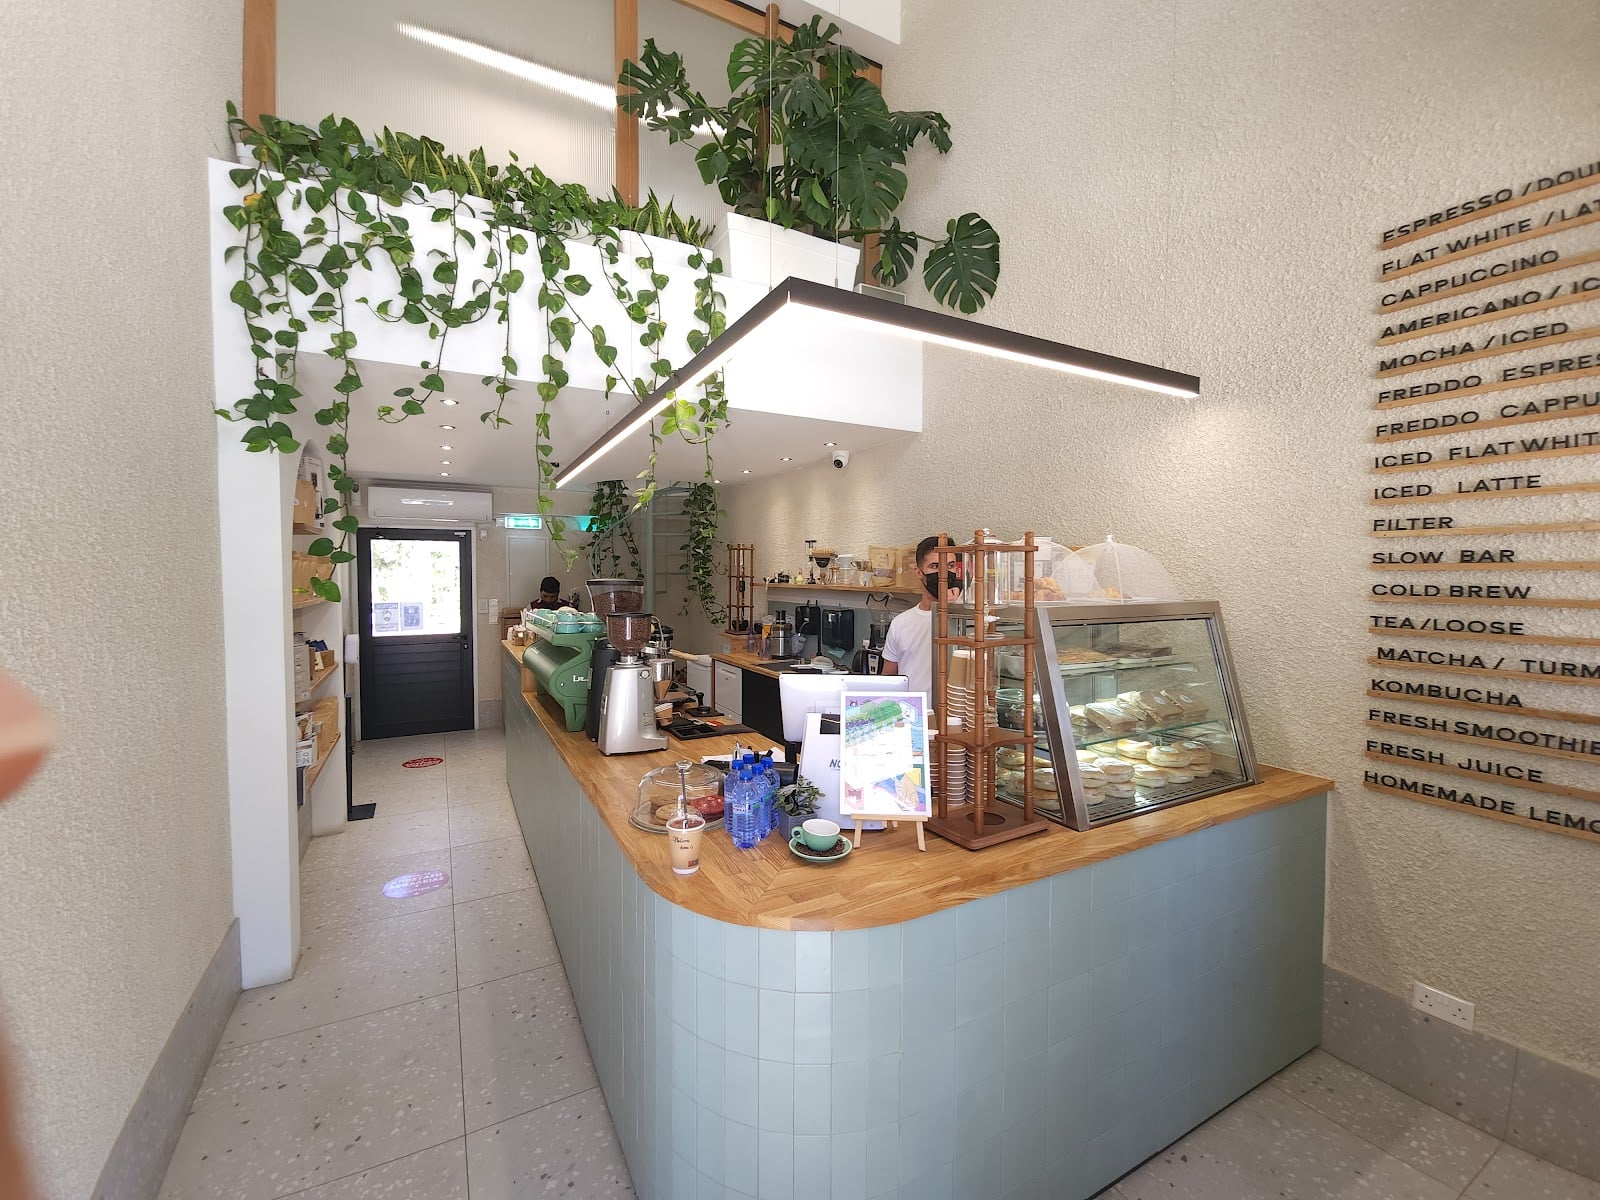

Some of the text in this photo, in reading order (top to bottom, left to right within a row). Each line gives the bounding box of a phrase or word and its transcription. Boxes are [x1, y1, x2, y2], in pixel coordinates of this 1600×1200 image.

[1382, 246, 1440, 276] FLAT
[1446, 218, 1533, 254] WHITE
[1381, 250, 1559, 307] CAPPUCCINO
[1378, 353, 1600, 404] FREDDO ESPRE
[1376, 391, 1600, 438] FREDDO CAPPU
[1374, 431, 1599, 469] ICED FLAT WHIT
[1374, 475, 1542, 500] ICED LATTE
[1373, 517, 1454, 532] FILTER
[1372, 549, 1515, 564] SLOW BAR
[1371, 584, 1531, 600] COLD BREW
[1520, 659, 1600, 680] TURM
[1371, 679, 1523, 708] KOMBUCHA
[1369, 709, 1600, 756] FRESH SMOOTHIE
[1366, 740, 1544, 784] FRESH JUICE
[1364, 770, 1516, 815] HOMEMADE
